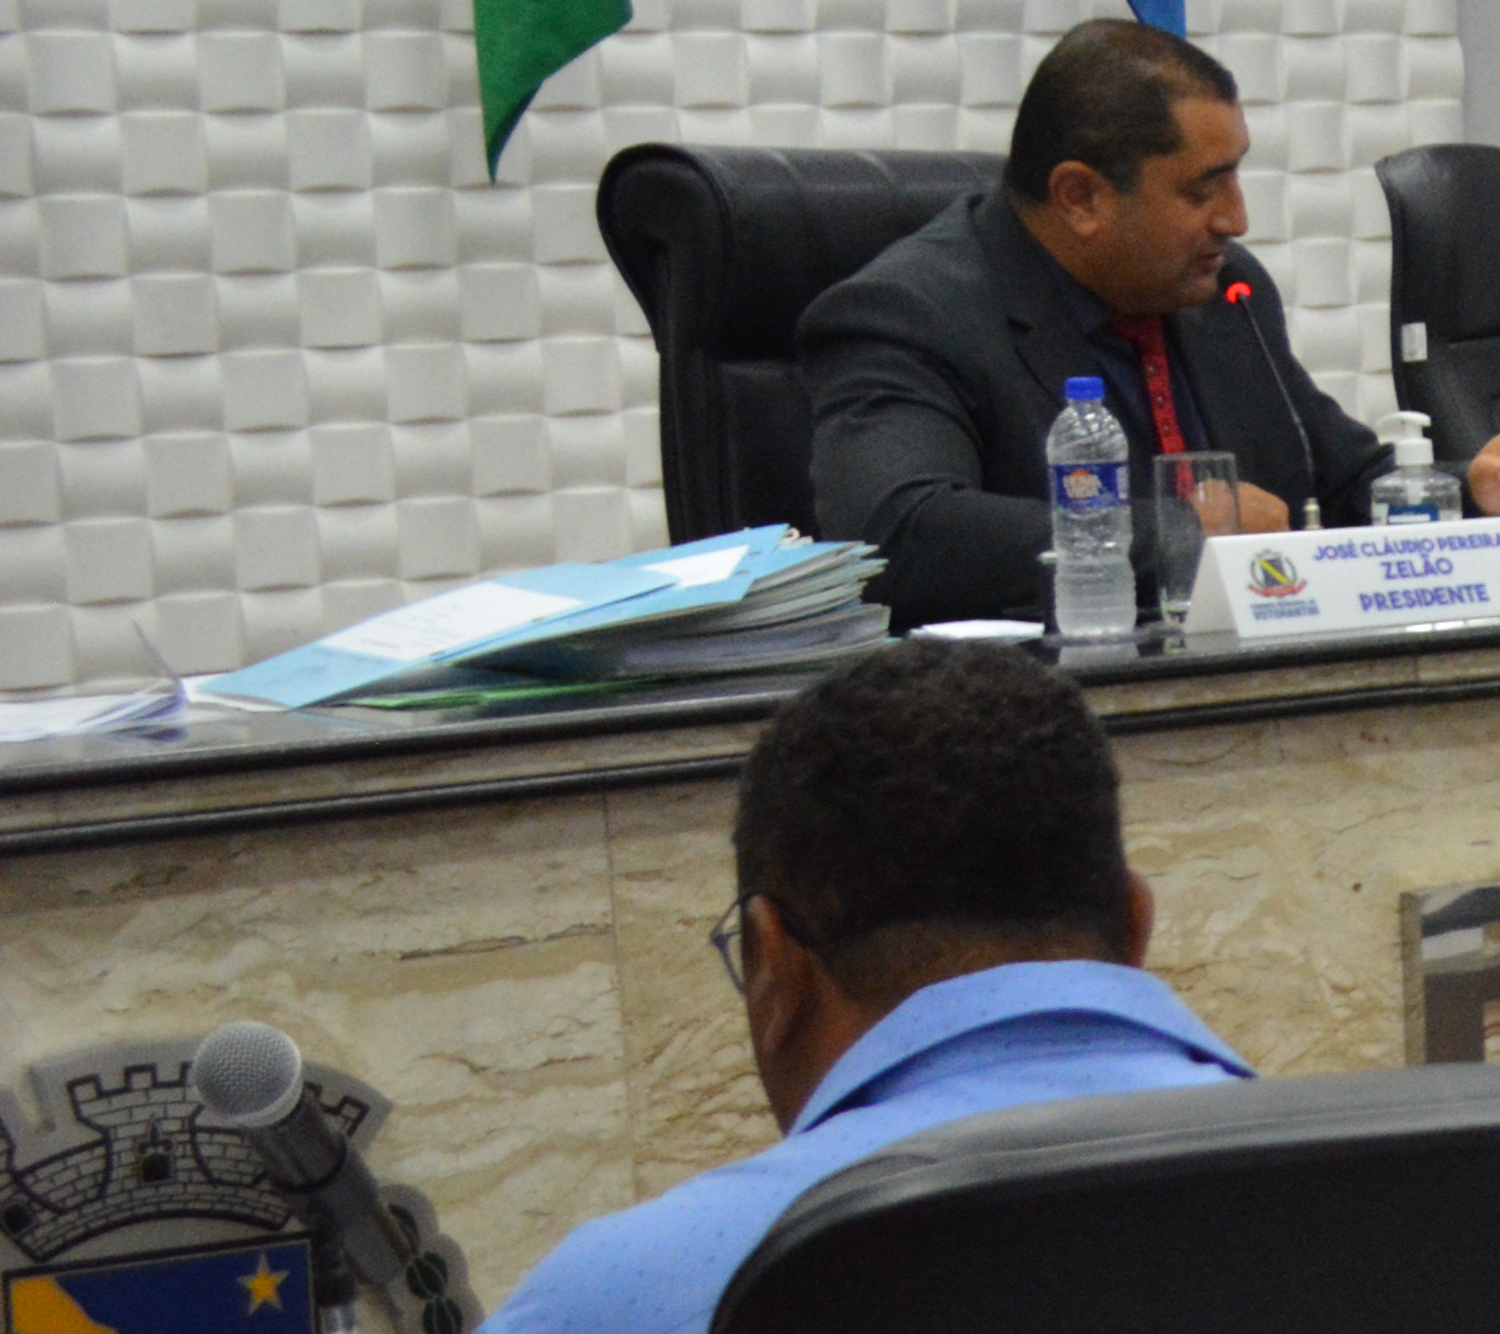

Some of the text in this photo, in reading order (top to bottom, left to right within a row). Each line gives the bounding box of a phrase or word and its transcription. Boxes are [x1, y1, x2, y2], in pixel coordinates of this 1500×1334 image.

[1314, 539, 1361, 561] JOSÉ
[1361, 534, 1435, 558] CLÁUDIO
[1380, 555, 1454, 580] ZELÃO
[1358, 582, 1490, 613] PRESIDENTE
